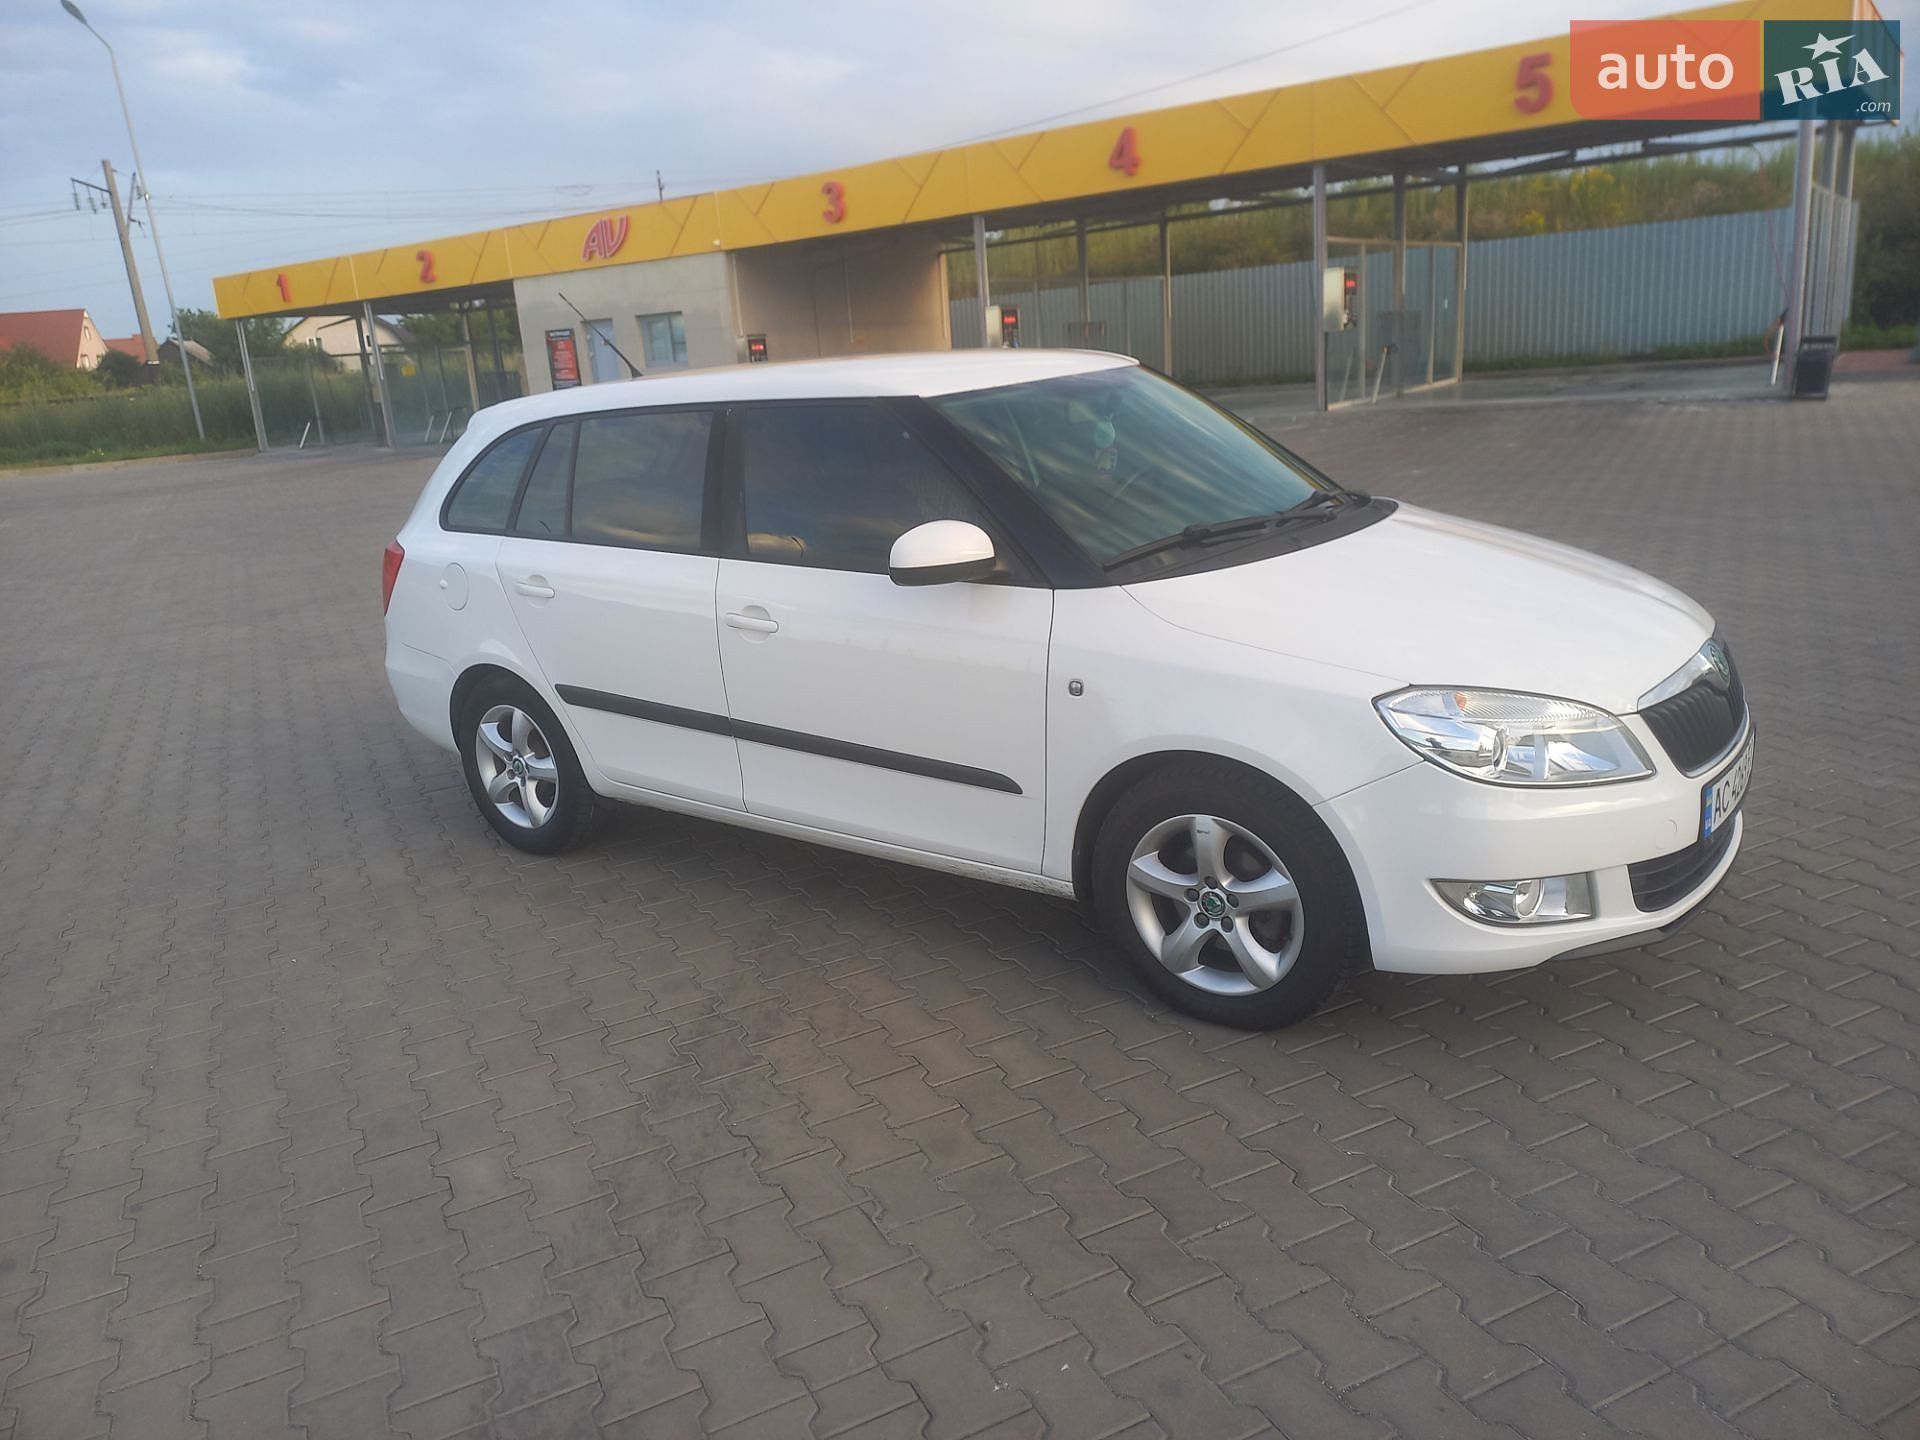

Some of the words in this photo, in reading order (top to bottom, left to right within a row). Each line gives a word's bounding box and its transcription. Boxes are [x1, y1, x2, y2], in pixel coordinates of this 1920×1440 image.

[1514, 53, 1553, 115] 5
[1109, 127, 1141, 176] 4
[821, 181, 847, 224] 3
[276, 272, 291, 304] 1
[416, 250, 437, 284] 2
[1713, 780, 1730, 824] AC
